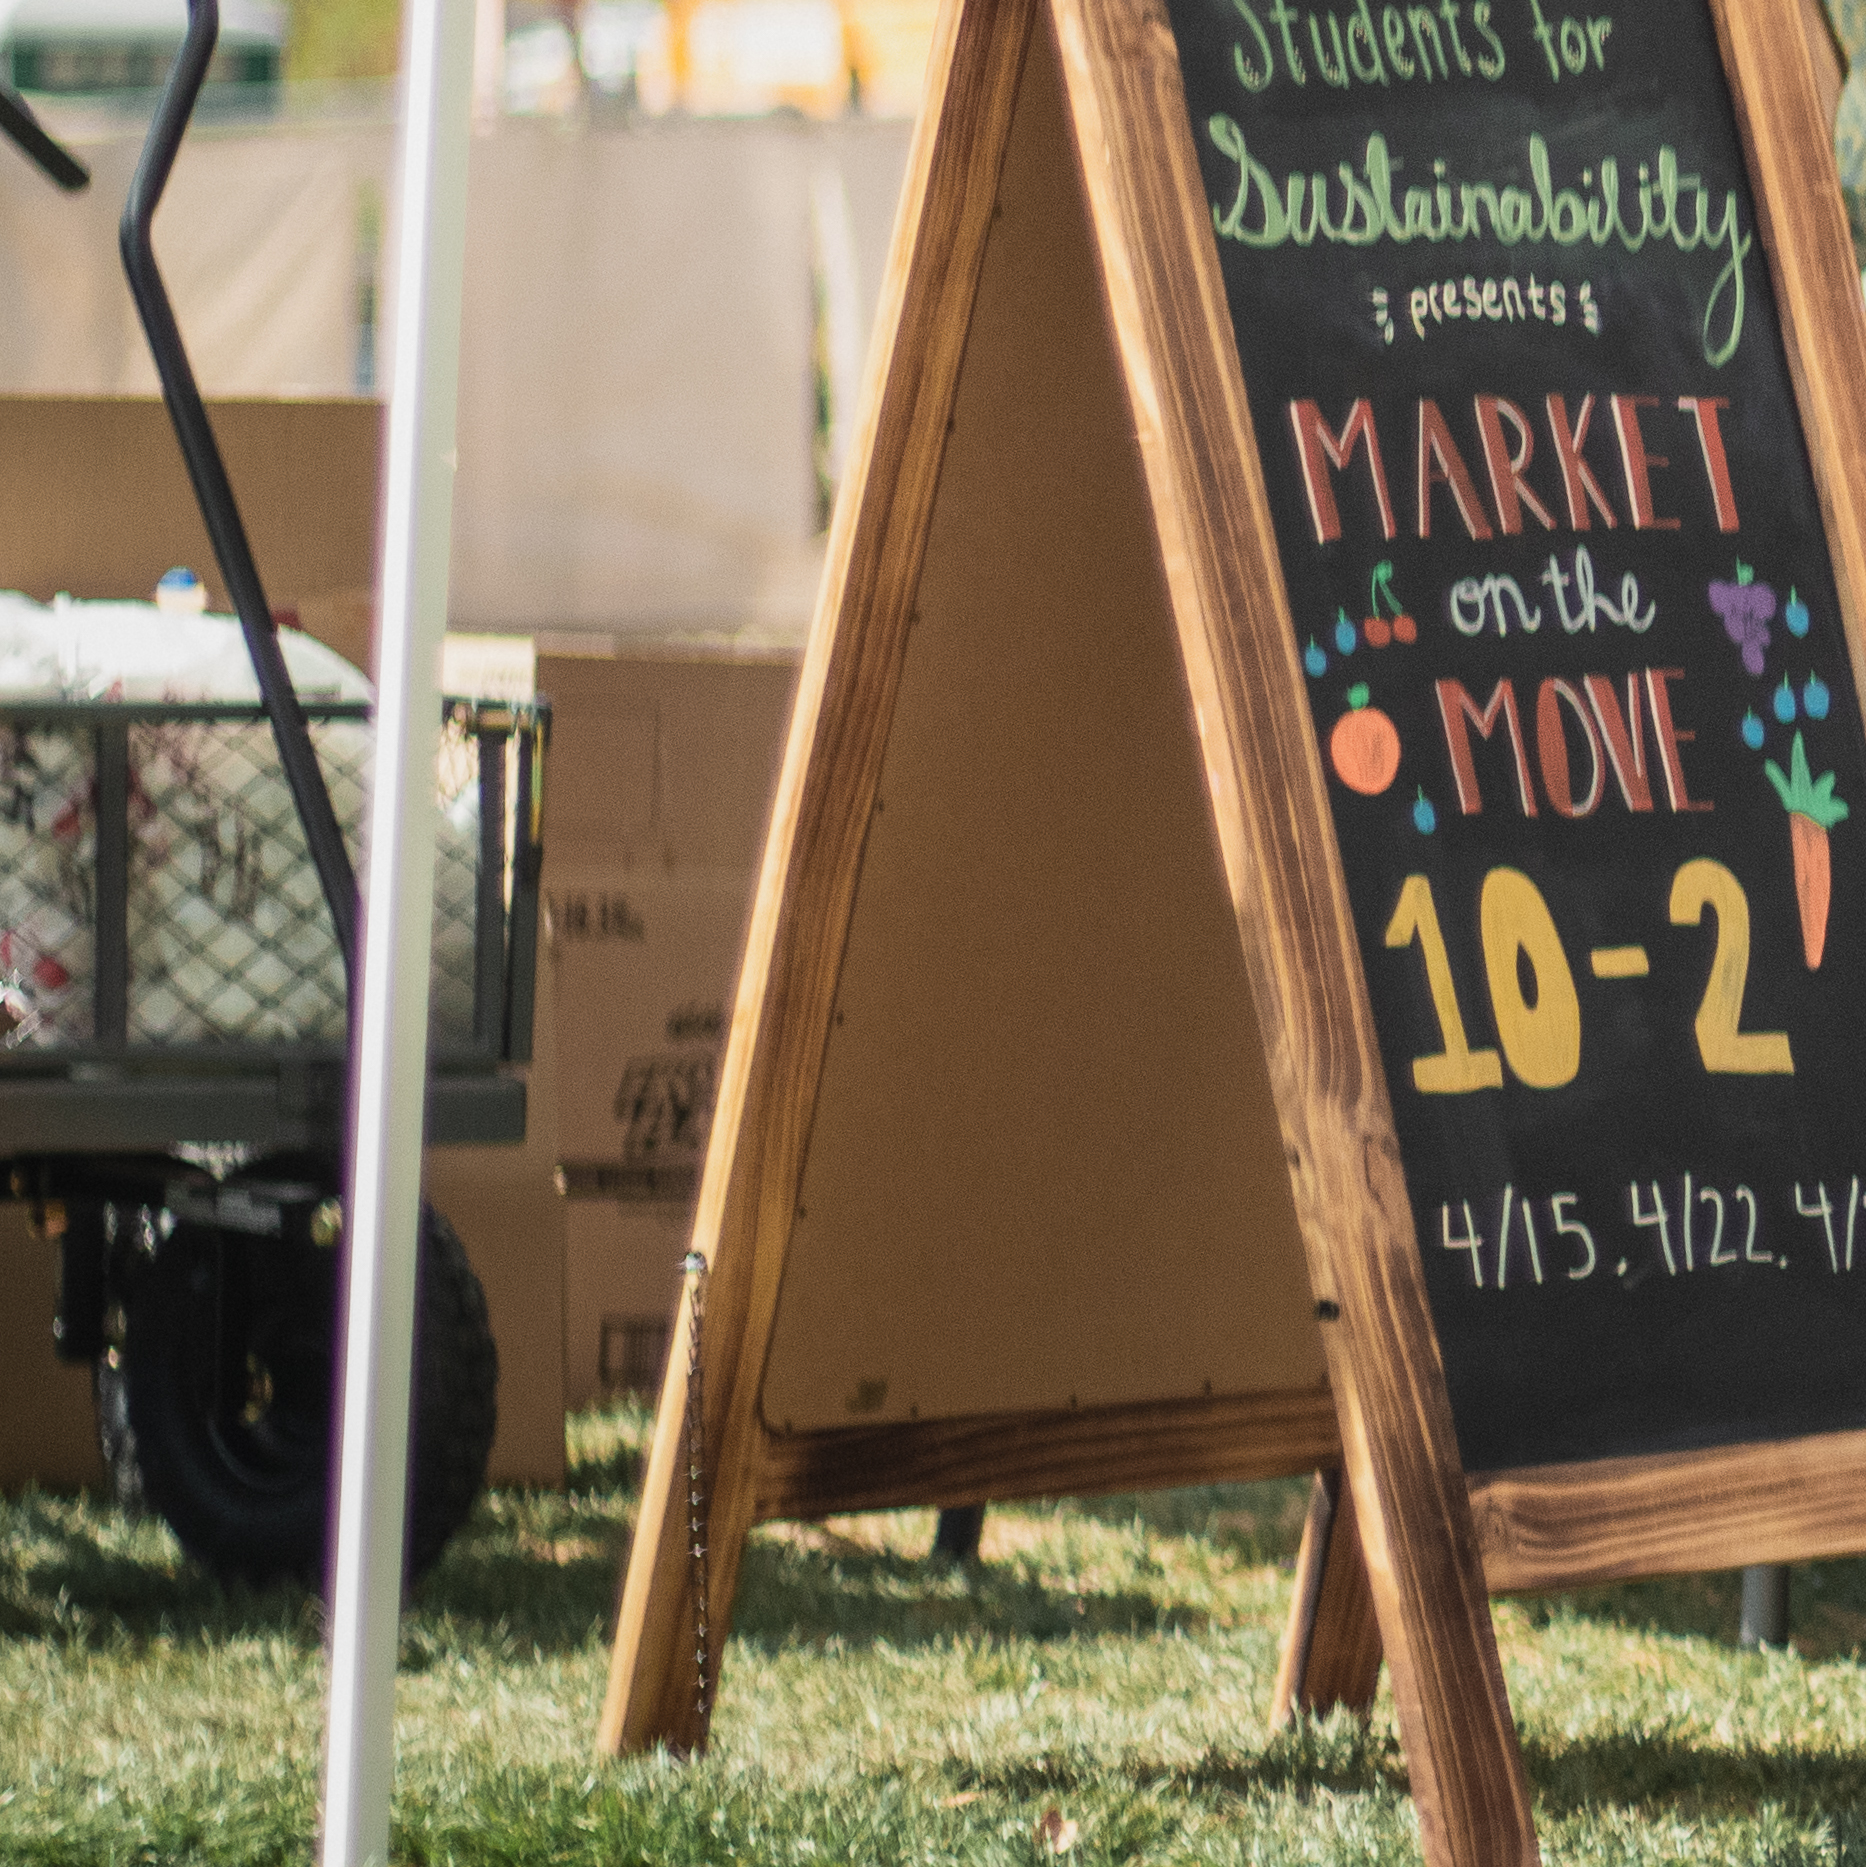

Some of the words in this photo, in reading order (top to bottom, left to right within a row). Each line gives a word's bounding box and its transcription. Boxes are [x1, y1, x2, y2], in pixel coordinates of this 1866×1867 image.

[1206, 113, 1752, 369] Sustainability
[1290, 392, 1740, 545] MARKET
[1449, 572, 1542, 638] on
[1540, 543, 1657, 635] the
[1434, 667, 1715, 820] MOVE
[1384, 857, 1796, 1095] 10-2
